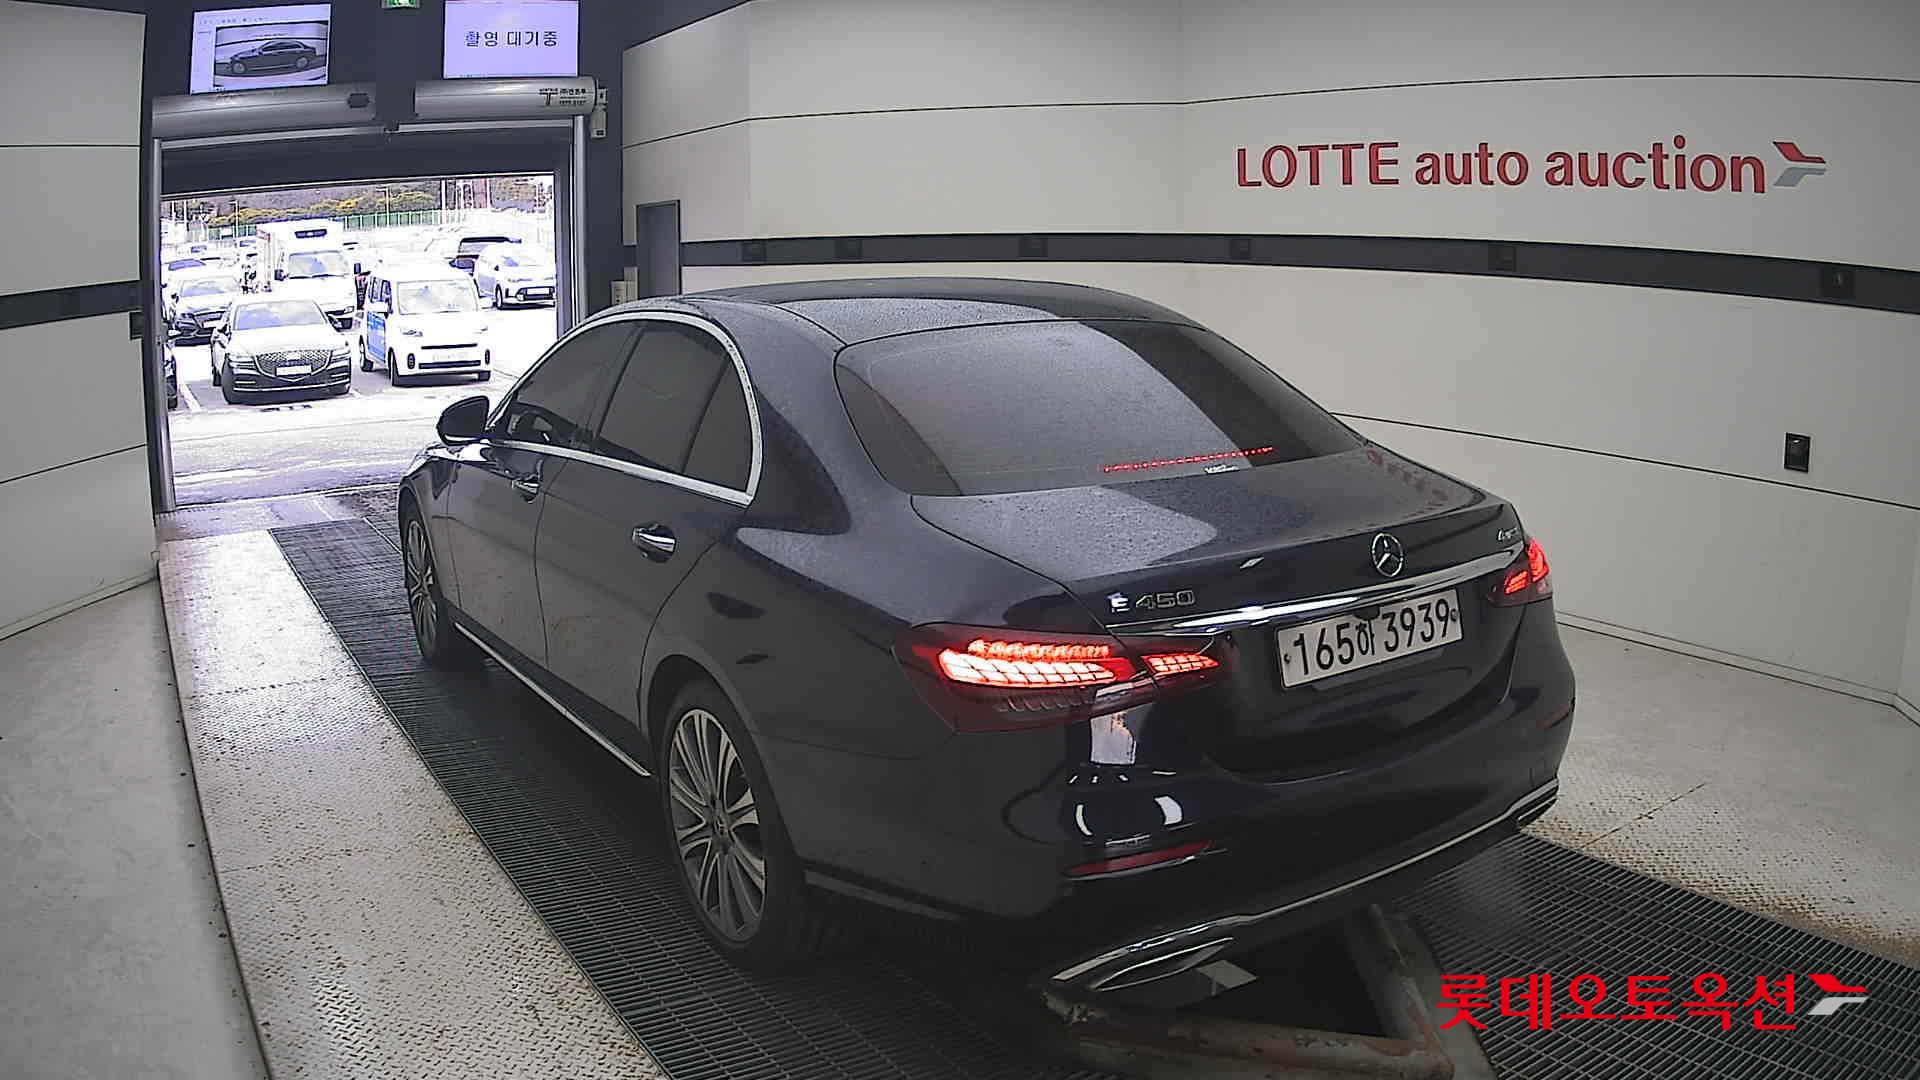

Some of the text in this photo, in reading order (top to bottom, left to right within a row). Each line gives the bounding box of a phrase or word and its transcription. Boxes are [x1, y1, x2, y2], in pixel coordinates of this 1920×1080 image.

[1237, 135, 1767, 193] LOTTE auto auction
[1136, 590, 1194, 609] 450
